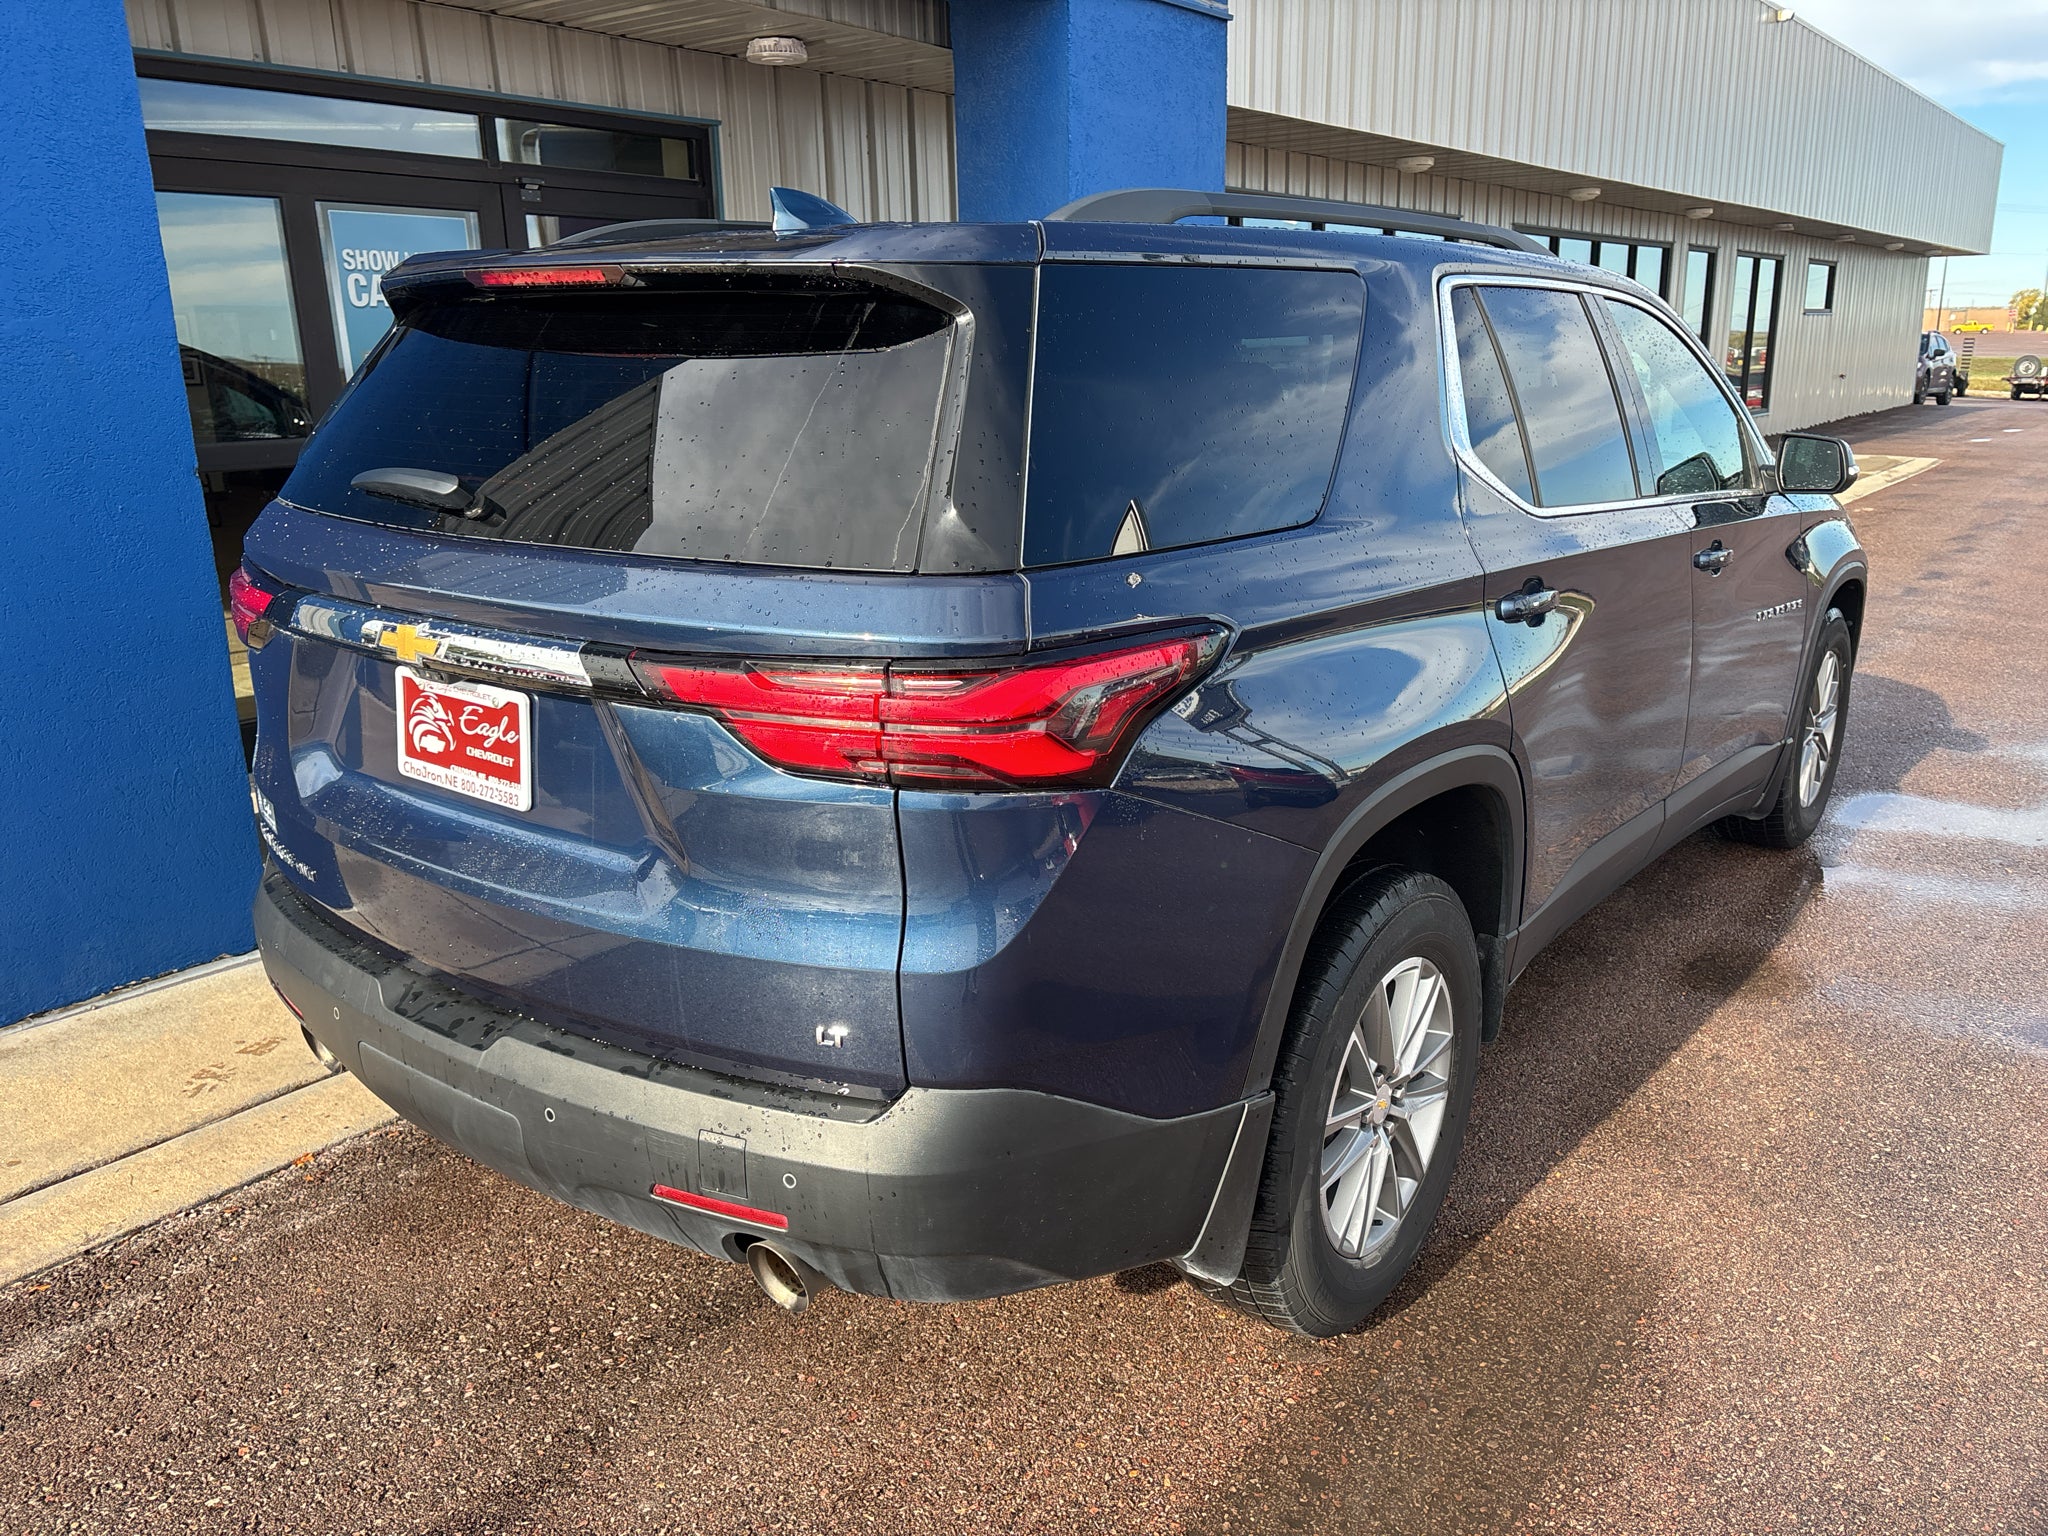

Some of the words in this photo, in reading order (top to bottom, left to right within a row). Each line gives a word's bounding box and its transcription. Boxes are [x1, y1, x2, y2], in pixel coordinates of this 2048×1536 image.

[342, 249, 399, 271] SHOW
[458, 705, 519, 748] Eagle
[466, 746, 515, 768] CHEVROLET
[816, 1025, 849, 1049] LT
